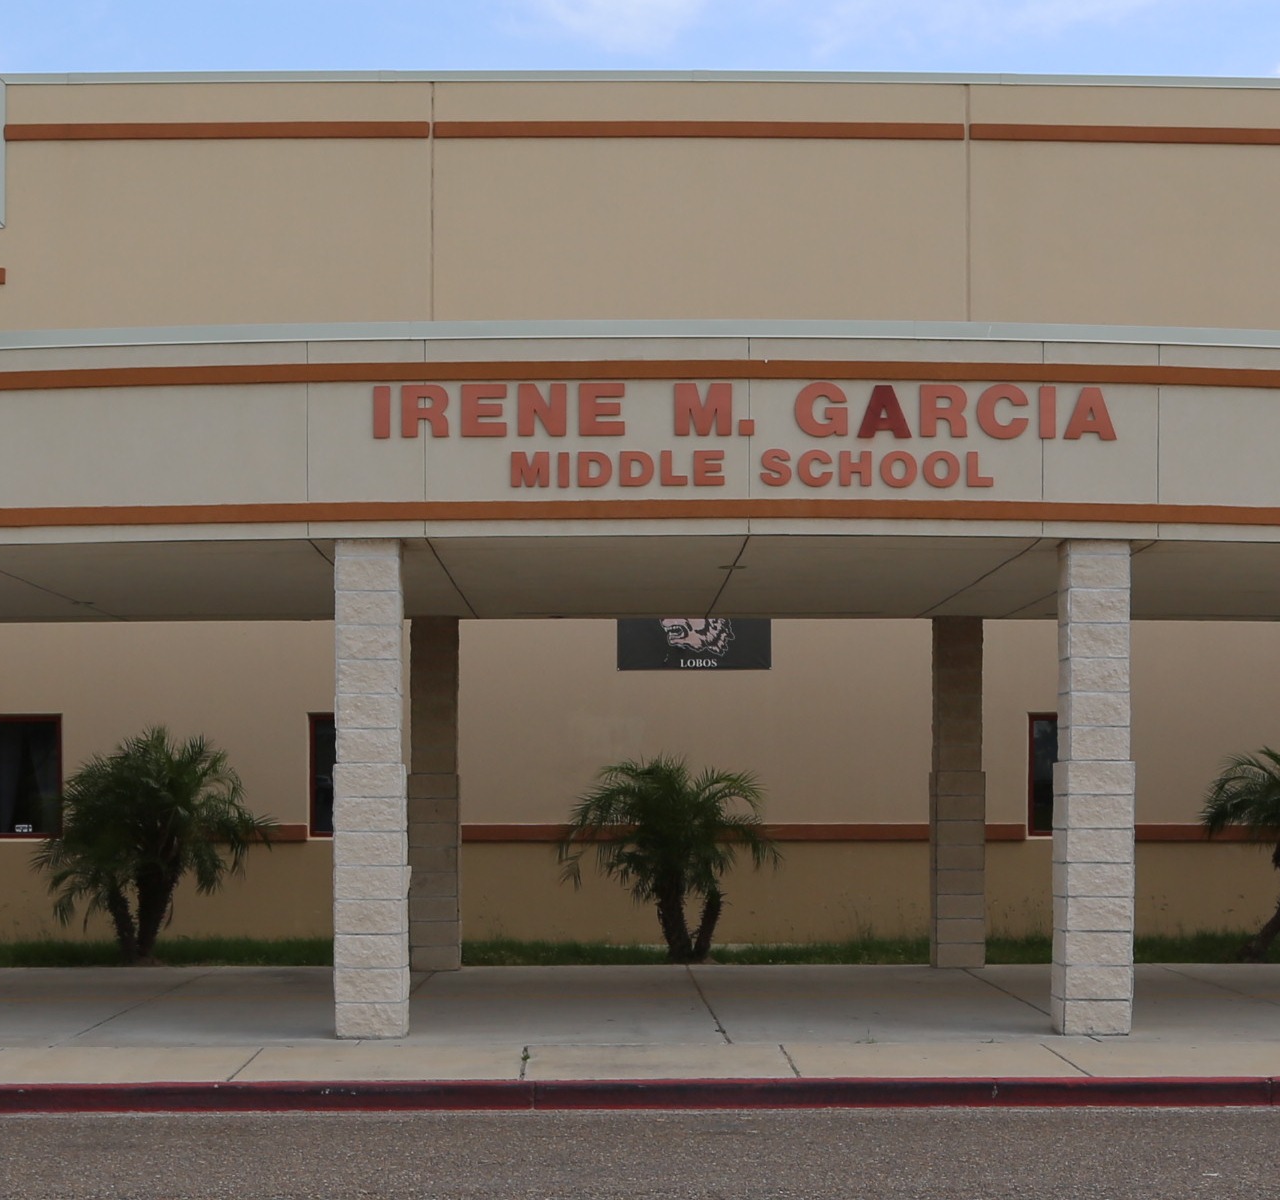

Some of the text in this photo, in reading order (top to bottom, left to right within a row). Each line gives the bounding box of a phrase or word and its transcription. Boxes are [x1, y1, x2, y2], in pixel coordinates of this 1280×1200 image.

[373, 381, 1117, 441] IRENE M. GARCIA
[511, 448, 994, 488] MIDDLE SCHOOL
[680, 658, 718, 668] LOBOS
